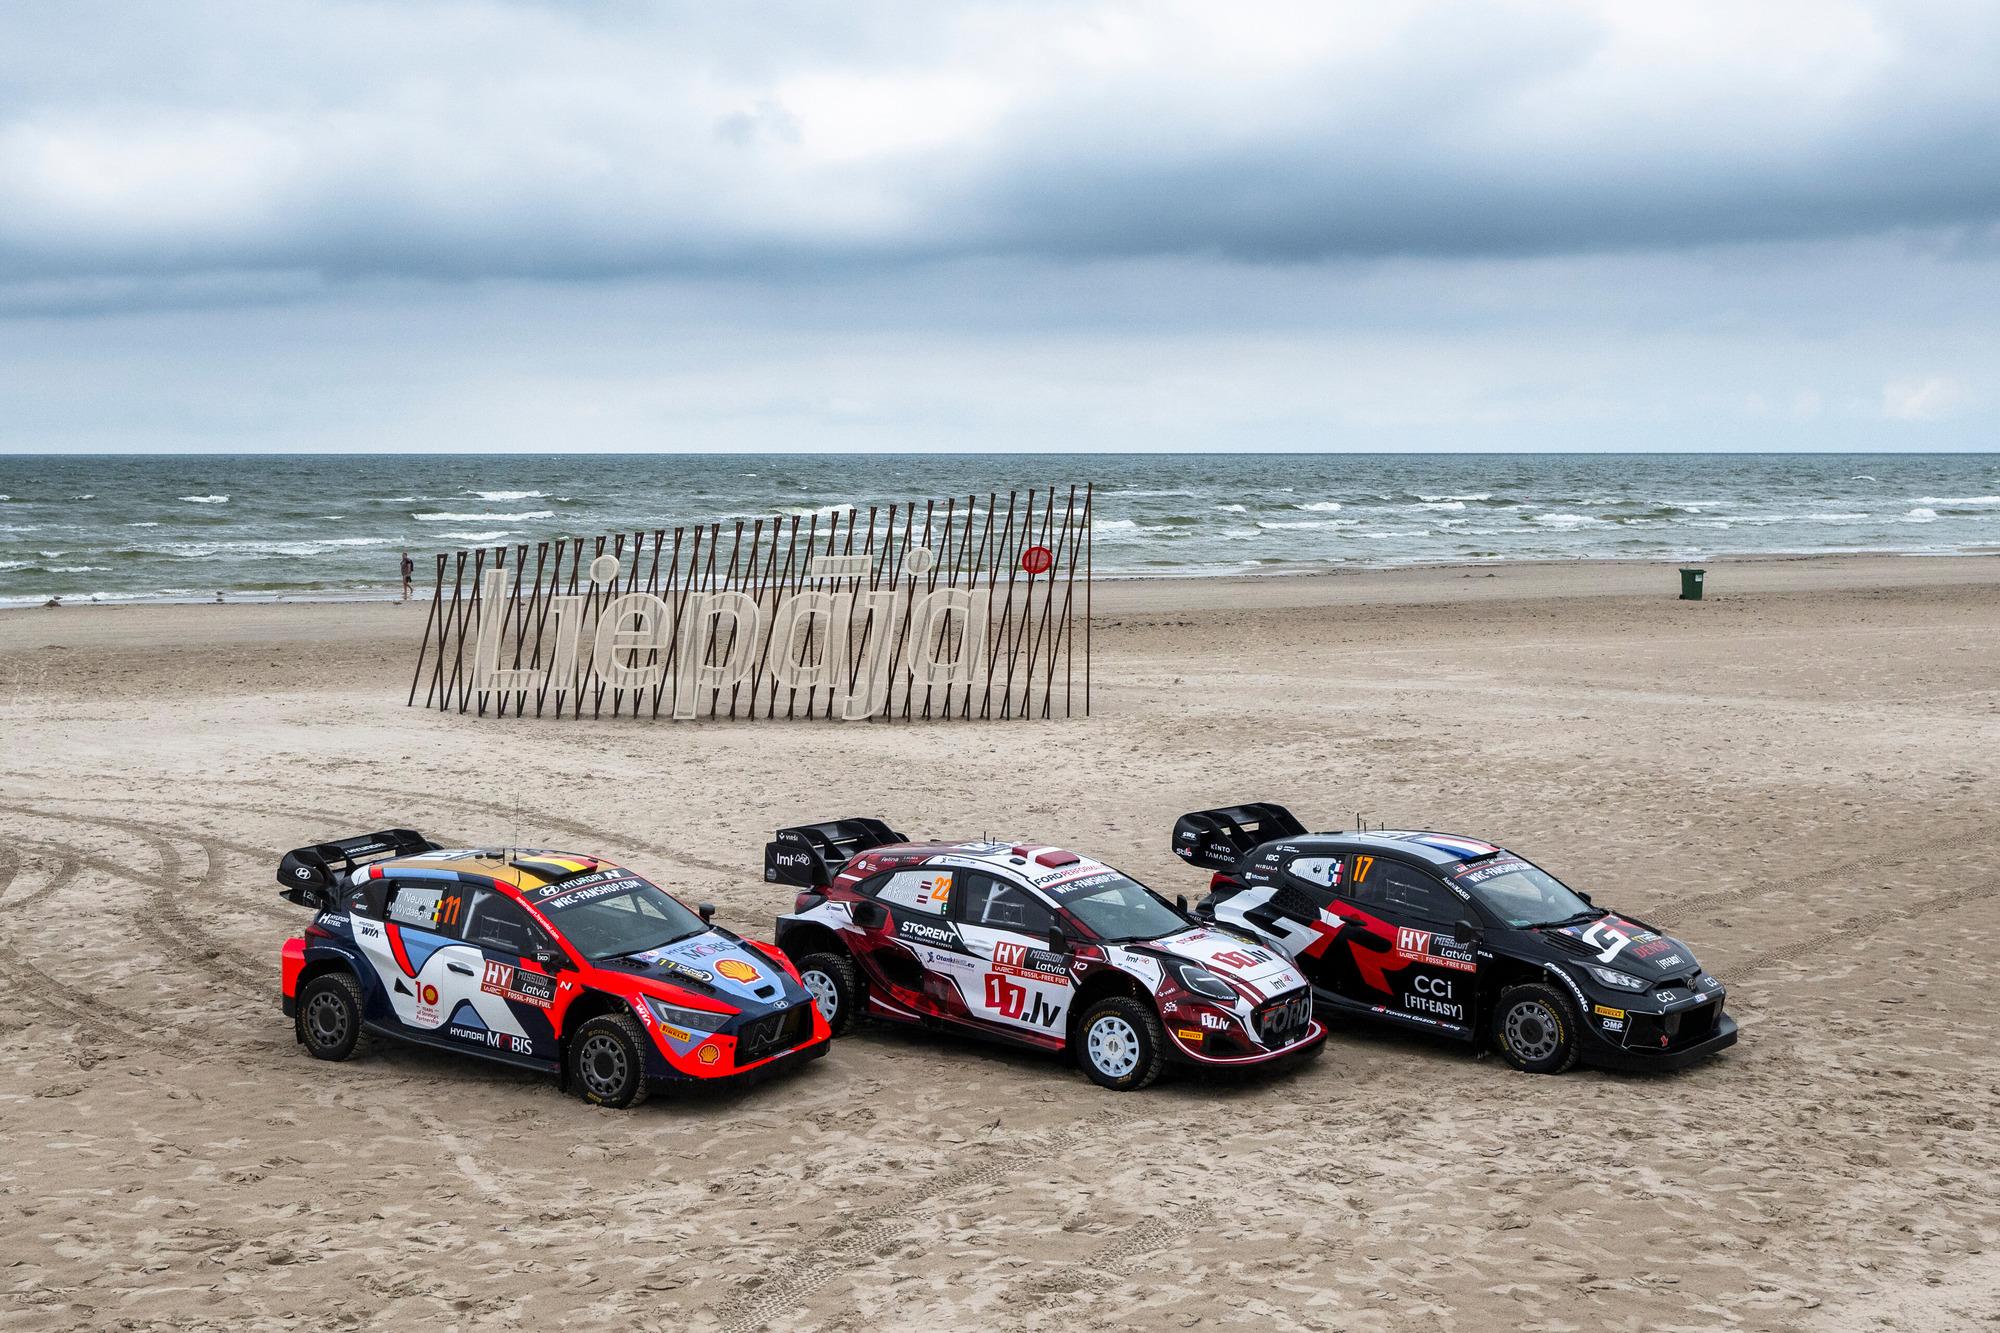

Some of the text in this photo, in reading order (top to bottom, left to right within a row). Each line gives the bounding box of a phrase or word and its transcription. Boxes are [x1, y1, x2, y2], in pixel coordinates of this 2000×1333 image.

[474, 547, 991, 720] Liepāja
[1353, 856, 1374, 882] 17
[559, 873, 604, 889] HYUNDAI
[931, 876, 952, 901] 22
[549, 879, 642, 909] WRC-FANSHOP.COM
[444, 895, 462, 925] 11
[362, 926, 379, 938] WIA
[901, 921, 956, 943] STORENT
[1400, 929, 1428, 952] HY
[681, 941, 738, 960] MOBIS
[996, 943, 1025, 965] HY
[1029, 949, 1064, 964] MISSION
[1440, 947, 1472, 961] Latvia
[1035, 961, 1066, 975] Latvia
[1425, 956, 1460, 968] FOSSIL-FREE
[1460, 963, 1474, 971] FUEL
[486, 962, 512, 987] HY
[517, 971, 549, 986] MISSION
[1020, 970, 1054, 982] FOSSIL-FREE
[1054, 976, 1069, 985] FUEL
[521, 982, 550, 999] Latvia
[1414, 975, 1452, 999] CCi
[1543, 962, 1589, 1013] Panasonic
[507, 991, 539, 1006] FOSSIL-FREE
[539, 1000, 551, 1009] FUEL
[987, 976, 1062, 1028] 11.lv
[1261, 997, 1310, 1039] FORD
[1597, 1007, 1622, 1017] PIRELLI
[660, 1024, 690, 1041] PIRELLI
[1602, 1020, 1623, 1030] OMP
[450, 1027, 533, 1055] HYUNDAI MOBIS
[1179, 1031, 1202, 1040] PIRELLI
